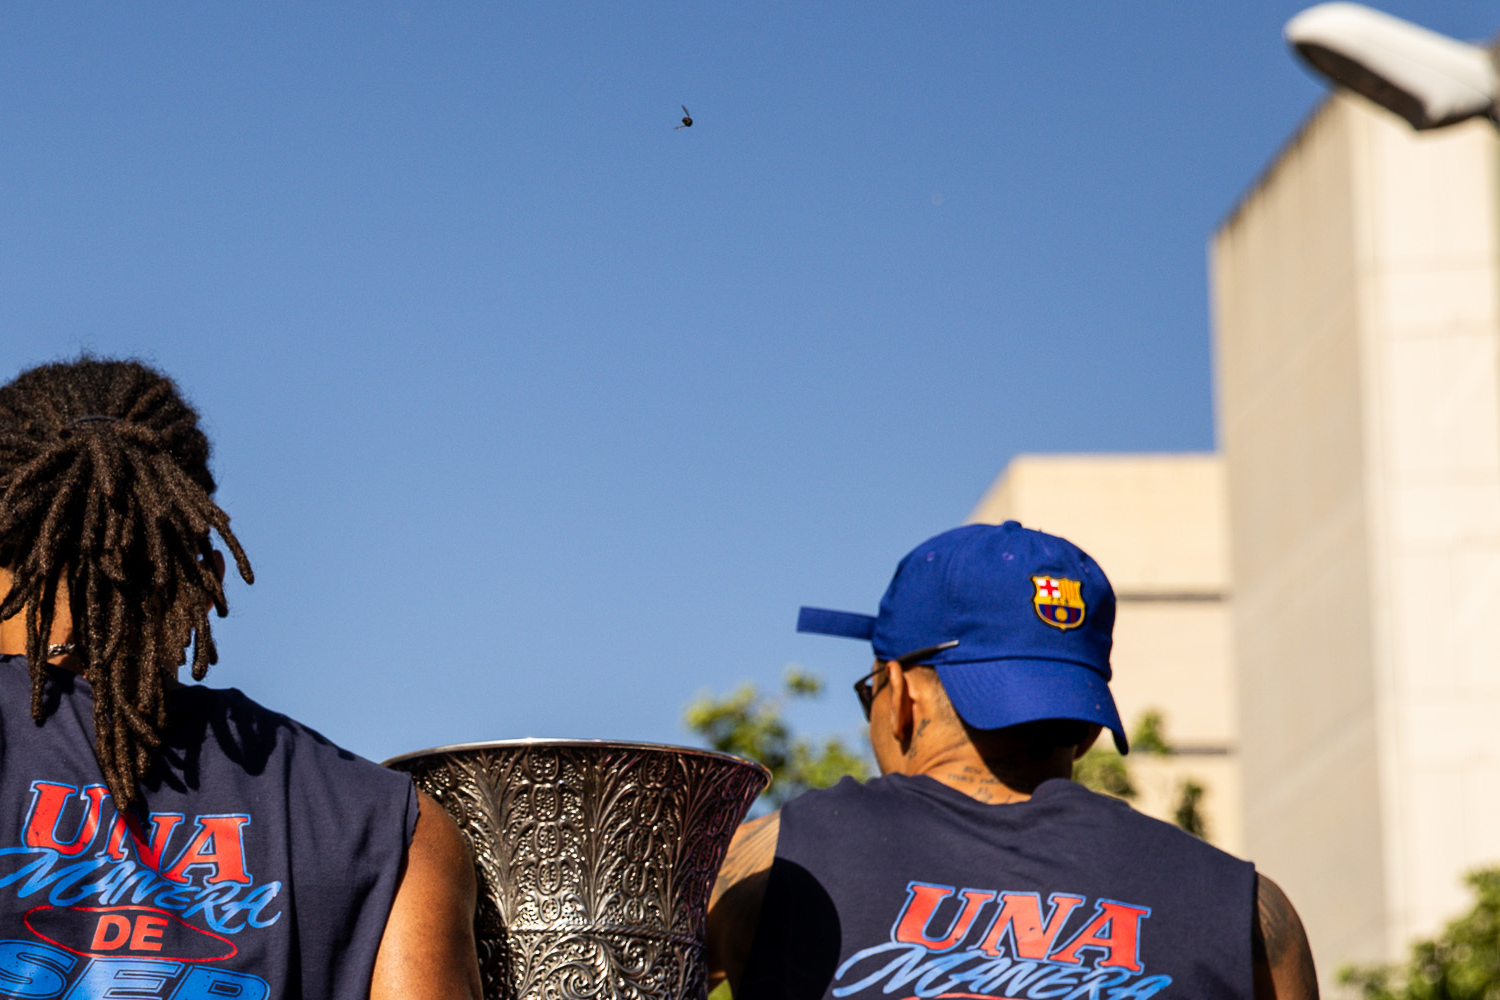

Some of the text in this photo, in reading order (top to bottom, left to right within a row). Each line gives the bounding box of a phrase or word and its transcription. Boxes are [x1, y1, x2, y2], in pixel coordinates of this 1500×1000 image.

[21, 780, 253, 886] UNA
[90, 914, 169, 951] DE
[891, 881, 1151, 975] UNA
